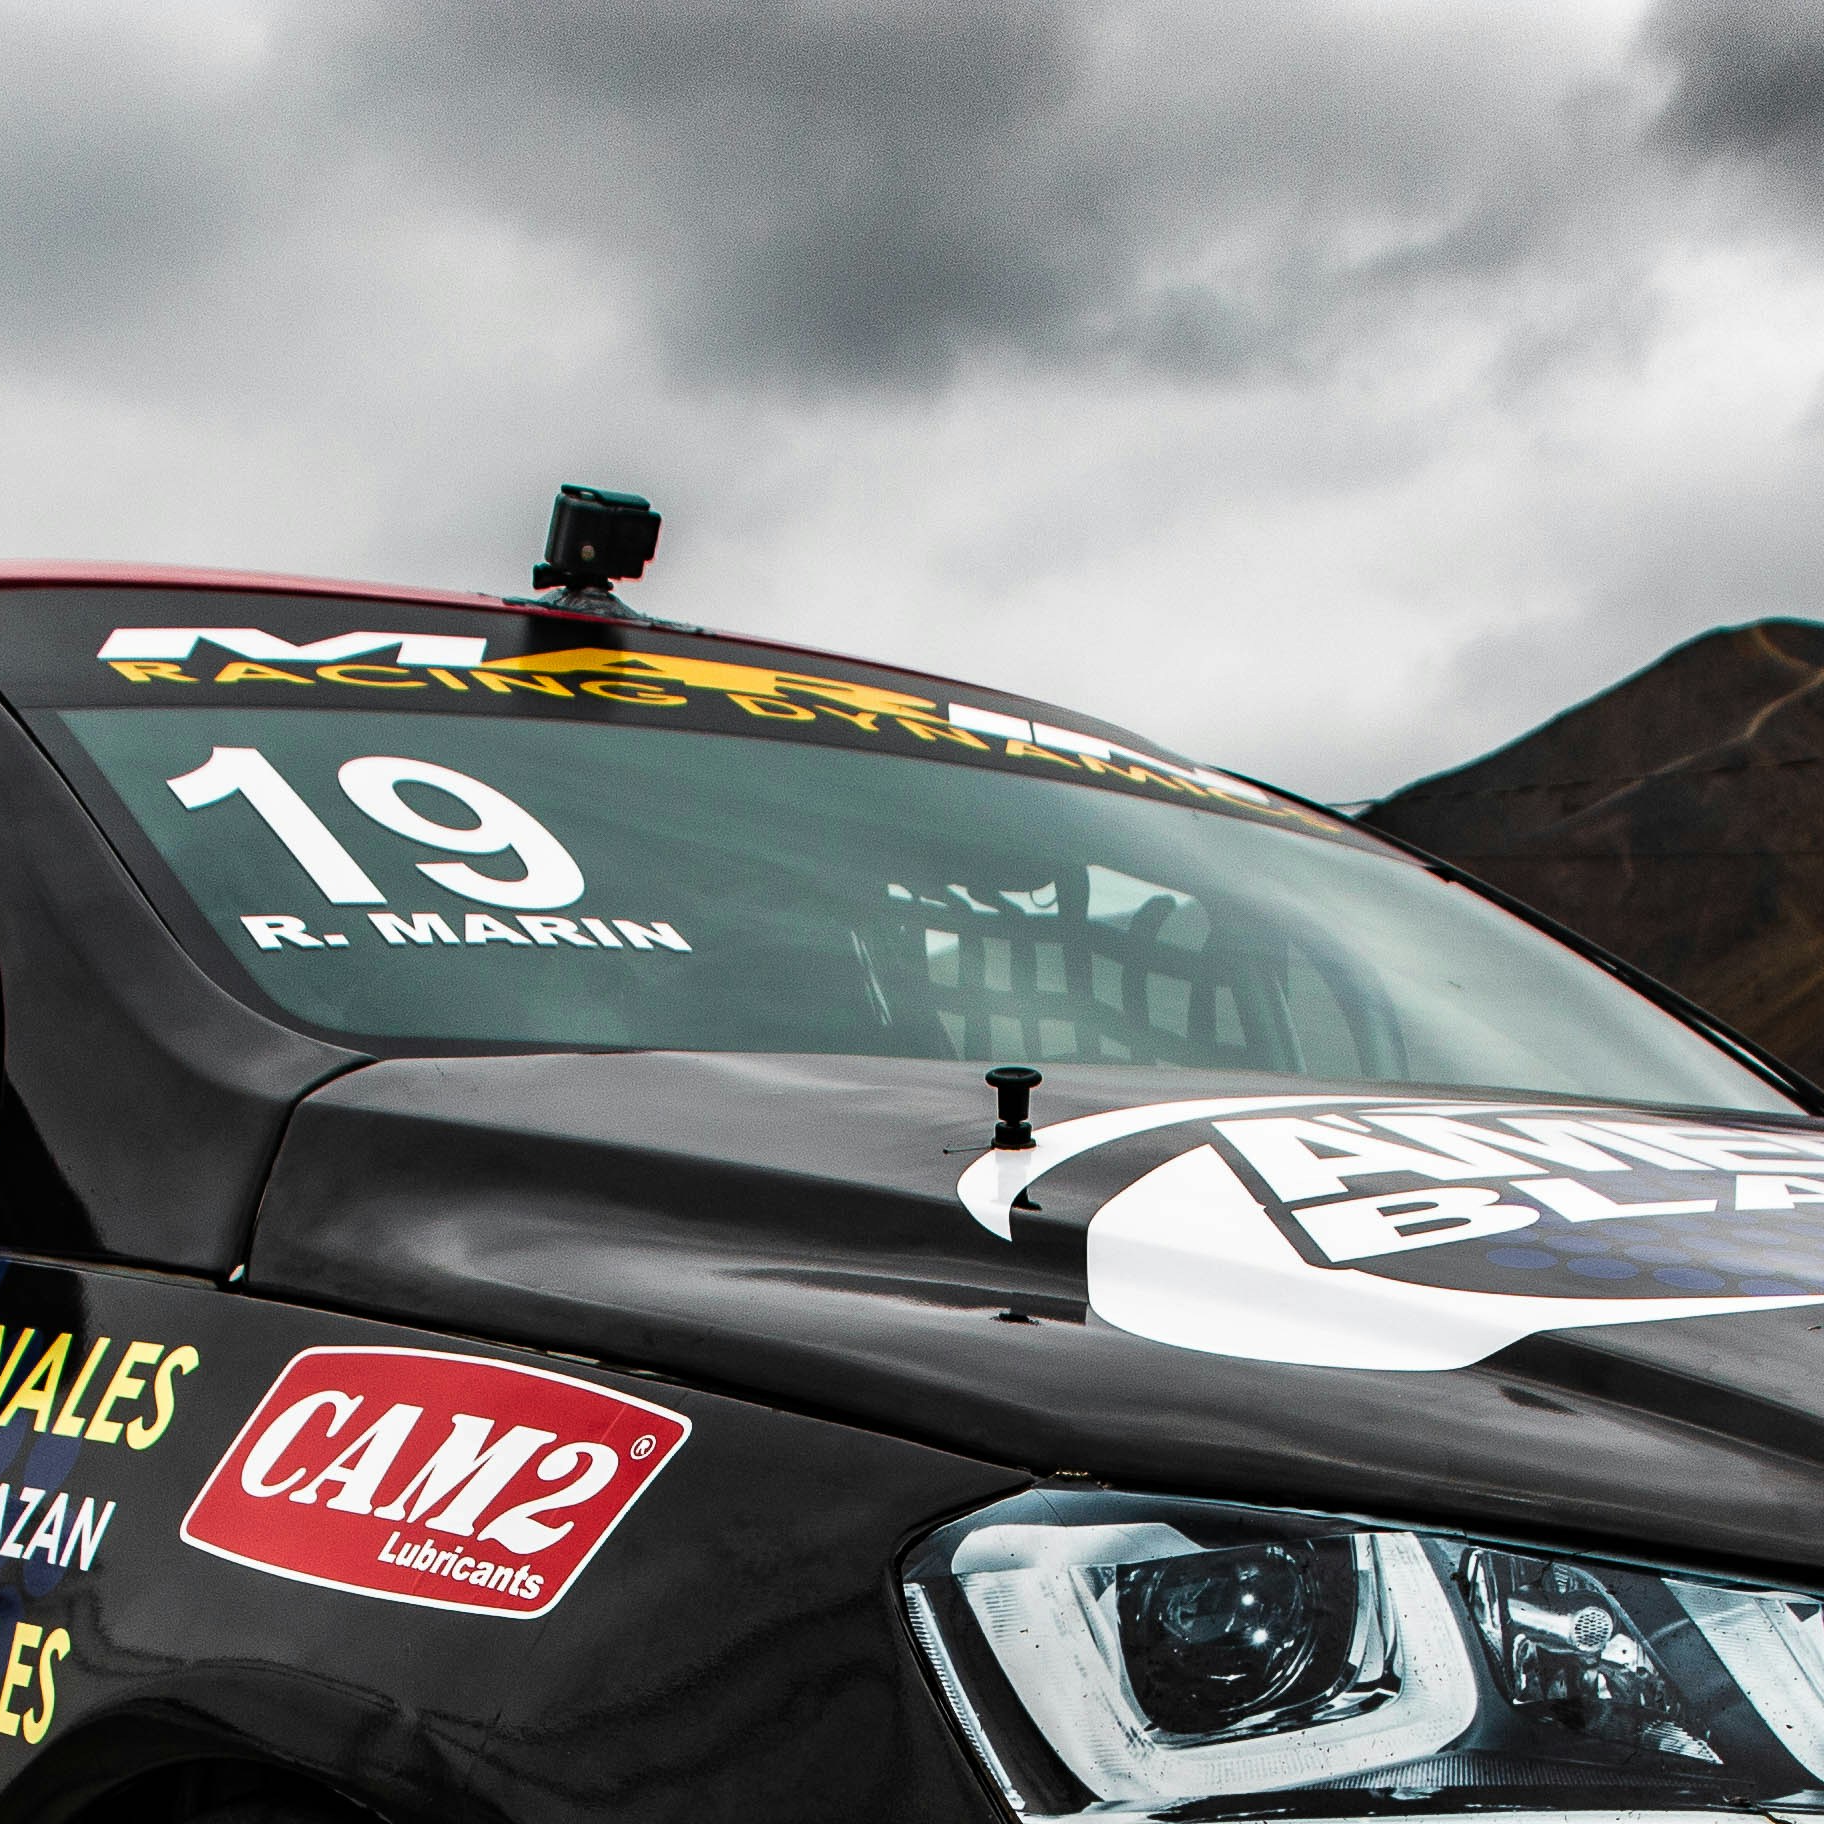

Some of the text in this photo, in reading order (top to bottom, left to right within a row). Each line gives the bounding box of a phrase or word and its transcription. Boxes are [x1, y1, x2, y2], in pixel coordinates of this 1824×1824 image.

[108, 661, 688, 707] RACING
[166, 746, 587, 911] 19
[240, 911, 693, 954] R. MARIN
[239, 1389, 619, 1556] CAM2
[376, 1530, 545, 1602] Lubricants
